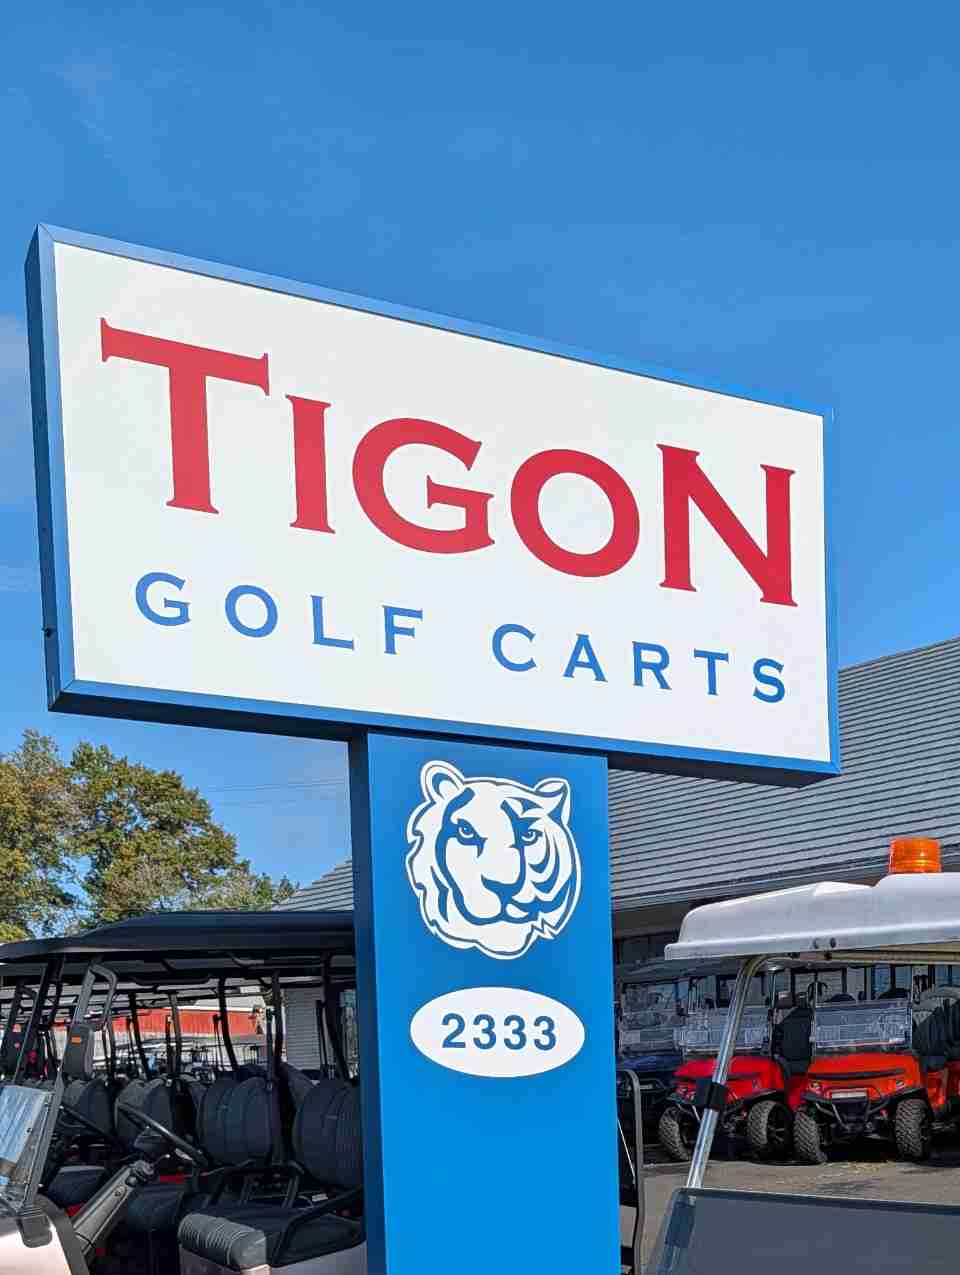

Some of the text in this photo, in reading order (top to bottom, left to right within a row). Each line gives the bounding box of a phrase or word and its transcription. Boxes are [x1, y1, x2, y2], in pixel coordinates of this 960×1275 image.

[99, 318, 797, 608] TIGON
[134, 571, 786, 705] GOLF CARTS
[441, 1011, 558, 1052] 2333
